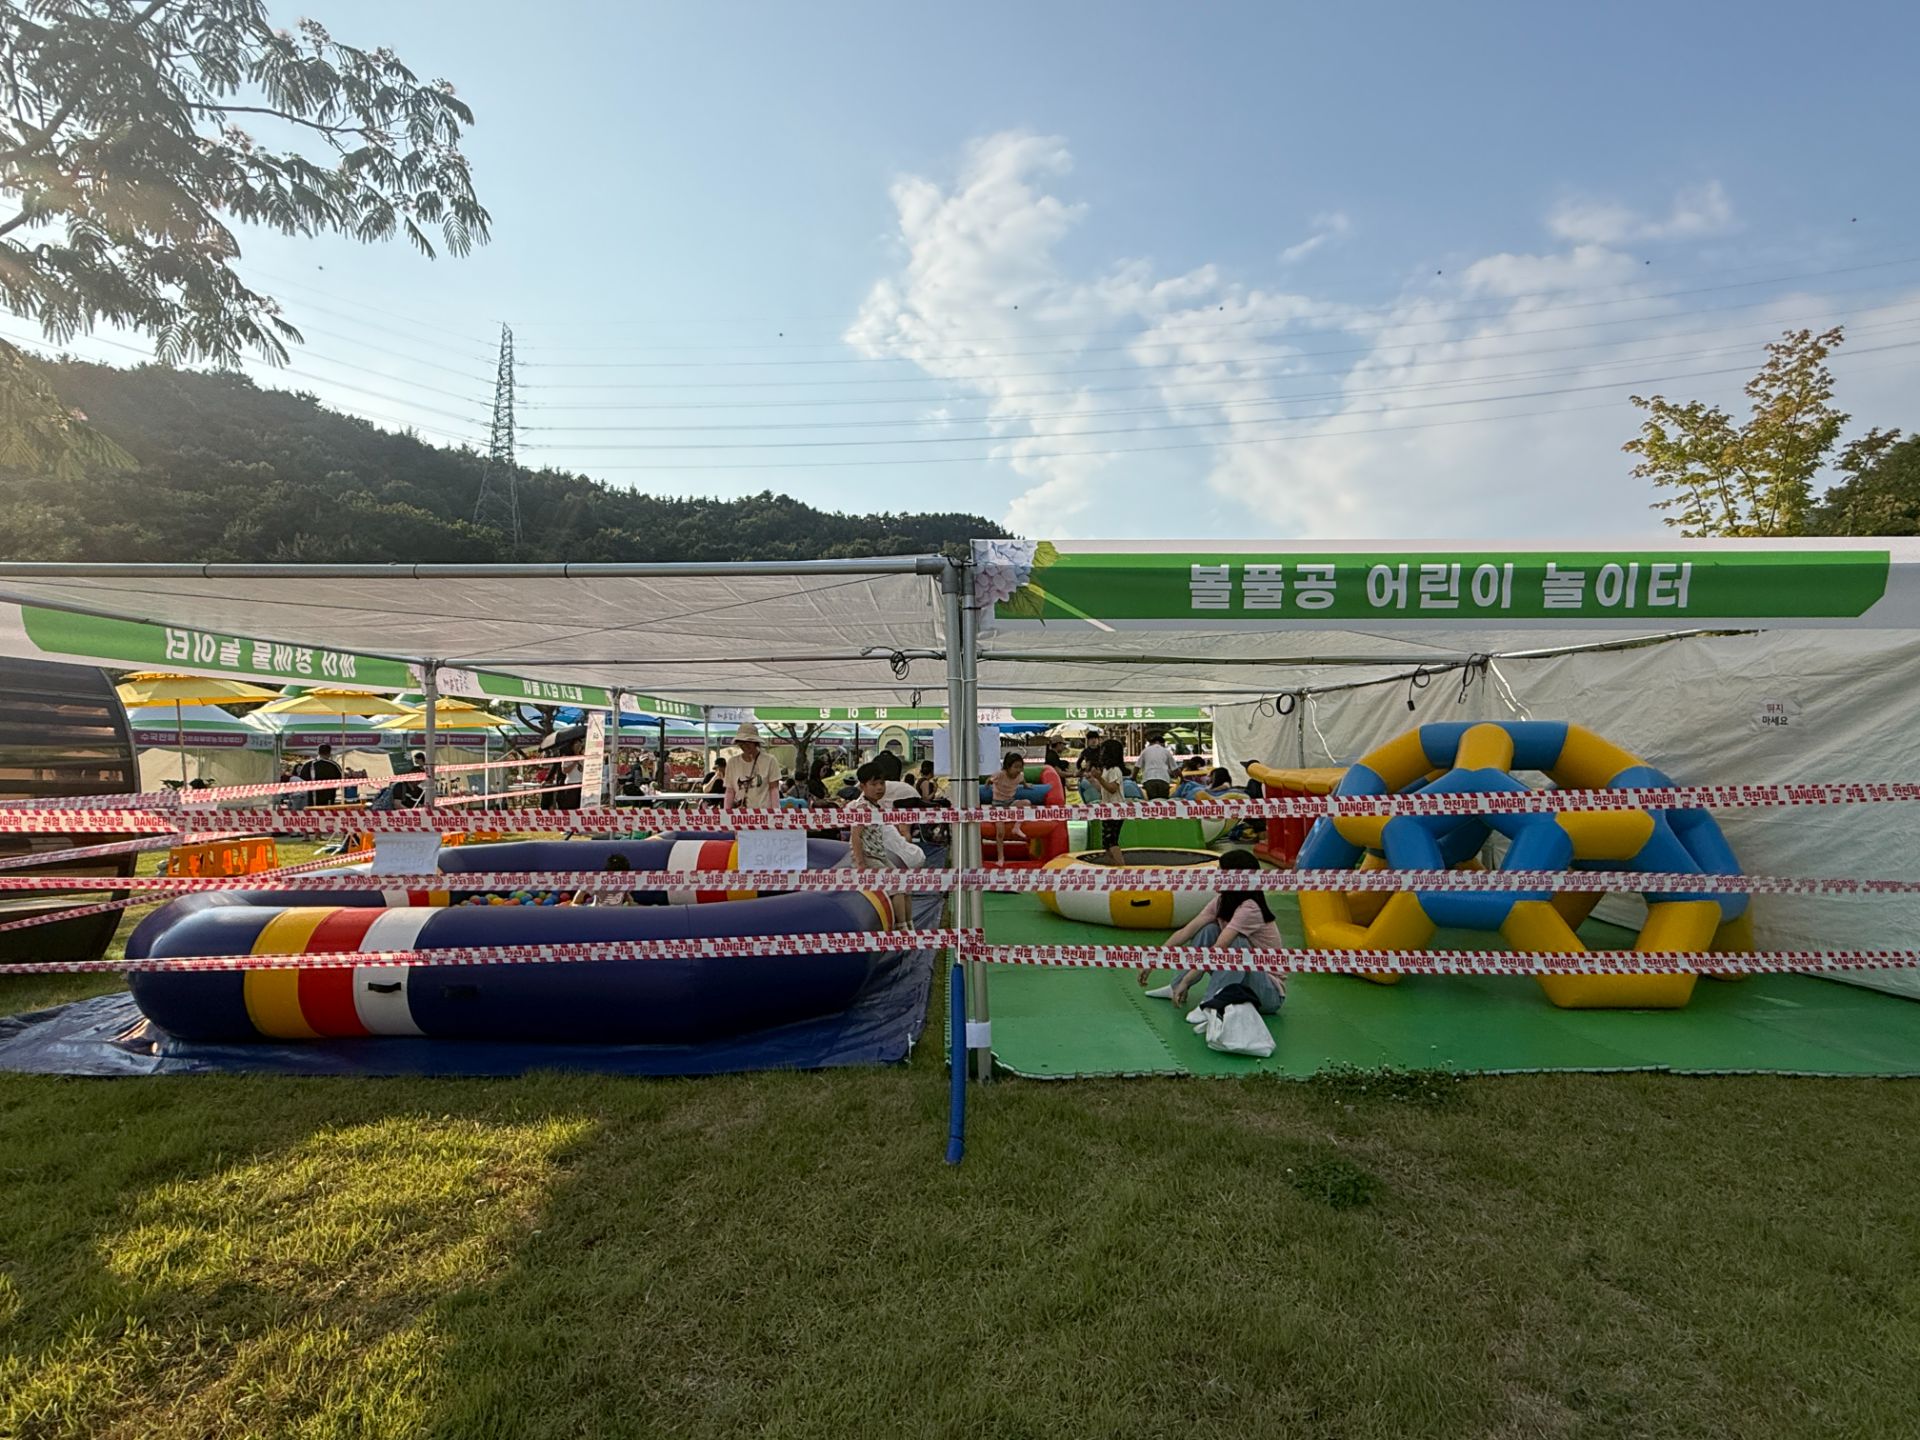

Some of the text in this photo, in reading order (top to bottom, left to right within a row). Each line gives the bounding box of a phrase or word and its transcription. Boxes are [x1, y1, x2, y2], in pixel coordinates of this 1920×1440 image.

[1189, 562, 1692, 609] 볼풀공 어린이 놀이터
[1762, 716, 1789, 726] 마세요
[89, 816, 123, 827] 안전제일
[134, 817, 171, 827] DANGER!
[238, 816, 272, 827] 안전제일
[283, 816, 320, 827] DANGER!
[386, 817, 422, 827] 안전제일
[432, 816, 468, 827] DANGER!
[536, 816, 570, 827] 안전제일
[581, 816, 618, 826] DANGER!
[686, 815, 720, 826] 안전제일
[731, 815, 768, 825] DANGER!
[836, 813, 872, 824] 안전제일
[882, 813, 920, 823] DANGER!
[989, 810, 1024, 821] 안전제일
[1035, 810, 1072, 820] DANGER!
[1141, 807, 1176, 818] 안전제일
[1187, 806, 1224, 816] DANGER!
[1292, 803, 1328, 814] 안전제일
[1338, 802, 1376, 812] DANGER!
[1444, 799, 1478, 810] 안전제일
[1488, 798, 1526, 808] DANGER!
[1593, 795, 1628, 806] 안전제일
[1638, 794, 1676, 804] DANGER!
[1788, 789, 1826, 800] DANGER!
[552, 948, 592, 957] DANGER!
[714, 942, 754, 952] DANGER!
[876, 936, 917, 946] DANGER!
[960, 946, 994, 956] DANGER!
[1061, 949, 1096, 960] 안전제일
[1106, 951, 1142, 962] DANGER!
[1209, 954, 1244, 964] 안전제일
[1253, 955, 1290, 966] DANGER!
[1355, 956, 1390, 968] 안전제일
[1398, 957, 1435, 968] DANGER!
[1500, 958, 1534, 968] 안전제일
[1544, 958, 1580, 968] DANGER!
[1644, 958, 1680, 968] 안전제일
[1688, 958, 1724, 968] DANGER!
